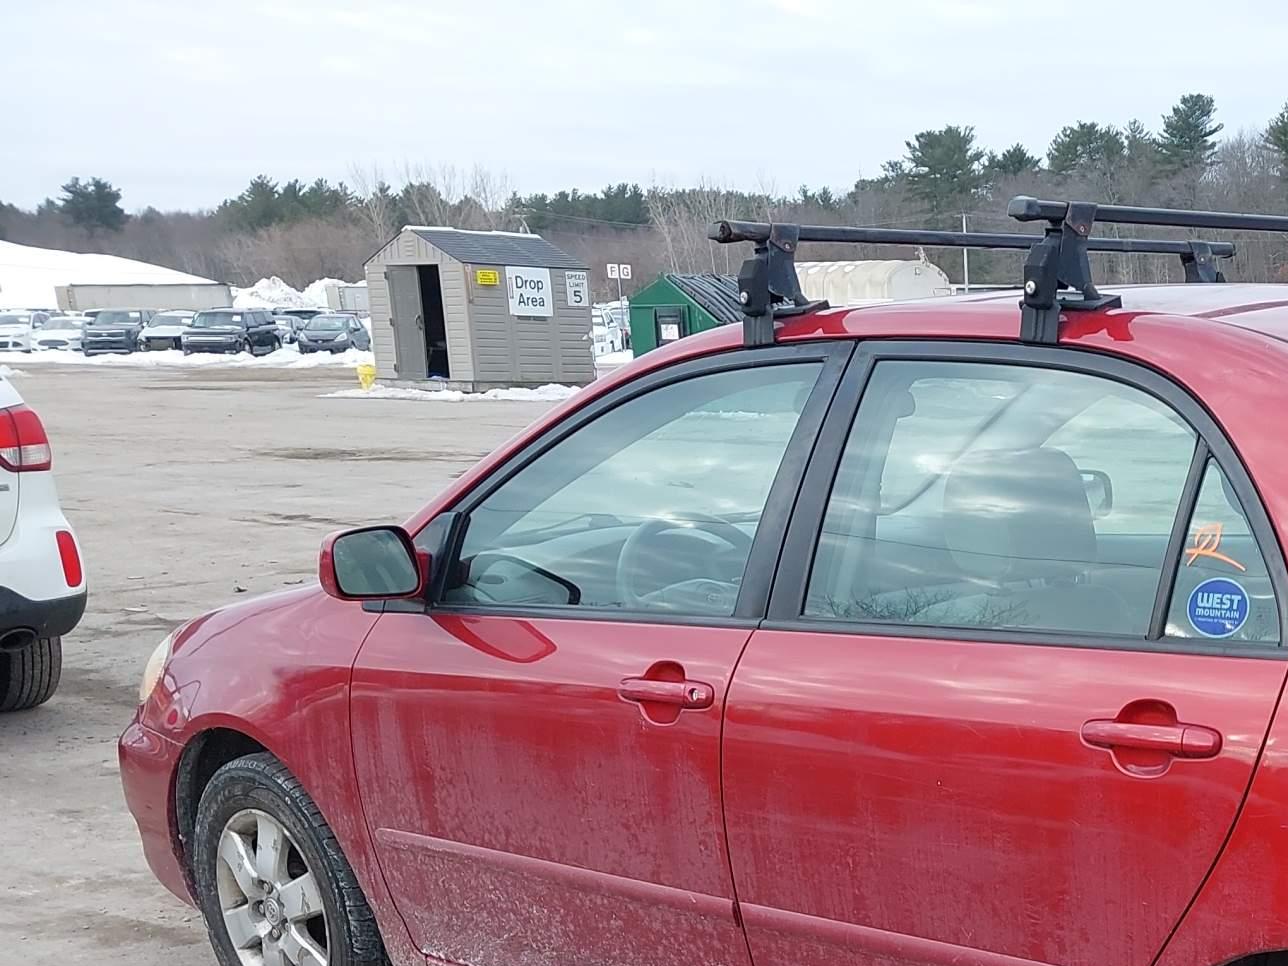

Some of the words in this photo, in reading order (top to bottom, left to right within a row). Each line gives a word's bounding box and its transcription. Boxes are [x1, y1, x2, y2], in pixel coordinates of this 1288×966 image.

[566, 273, 586, 281] SPEED
[609, 266, 617, 276] F
[621, 267, 630, 277] G
[515, 275, 544, 293] Drop
[568, 281, 584, 289] LIMIT
[518, 293, 545, 307] Area
[573, 290, 583, 304] 5
[1197, 592, 1242, 610] WEST
